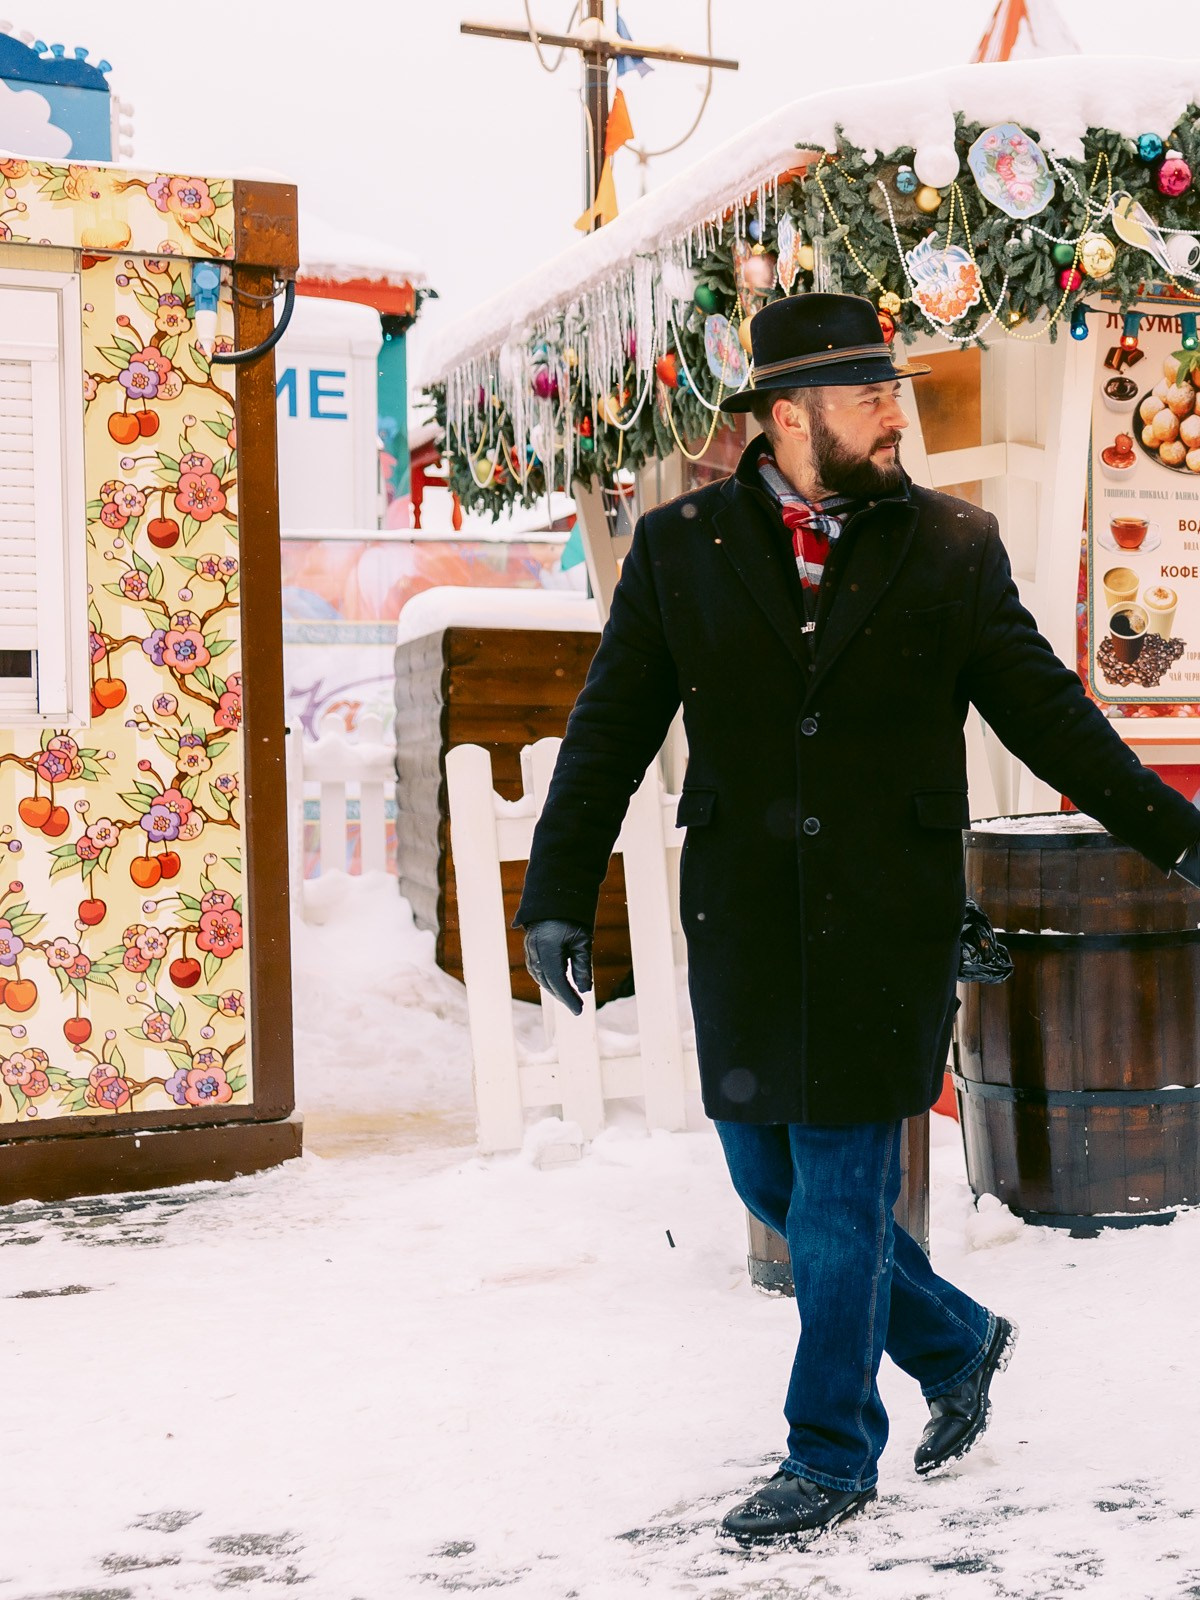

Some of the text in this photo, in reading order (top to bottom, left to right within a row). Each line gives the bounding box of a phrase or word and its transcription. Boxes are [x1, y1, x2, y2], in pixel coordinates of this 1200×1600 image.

[1106, 312, 1186, 334] ЛУМ
[1183, 542, 1199, 551] ВОДА
[1160, 565, 1199, 579] КОФЕ
